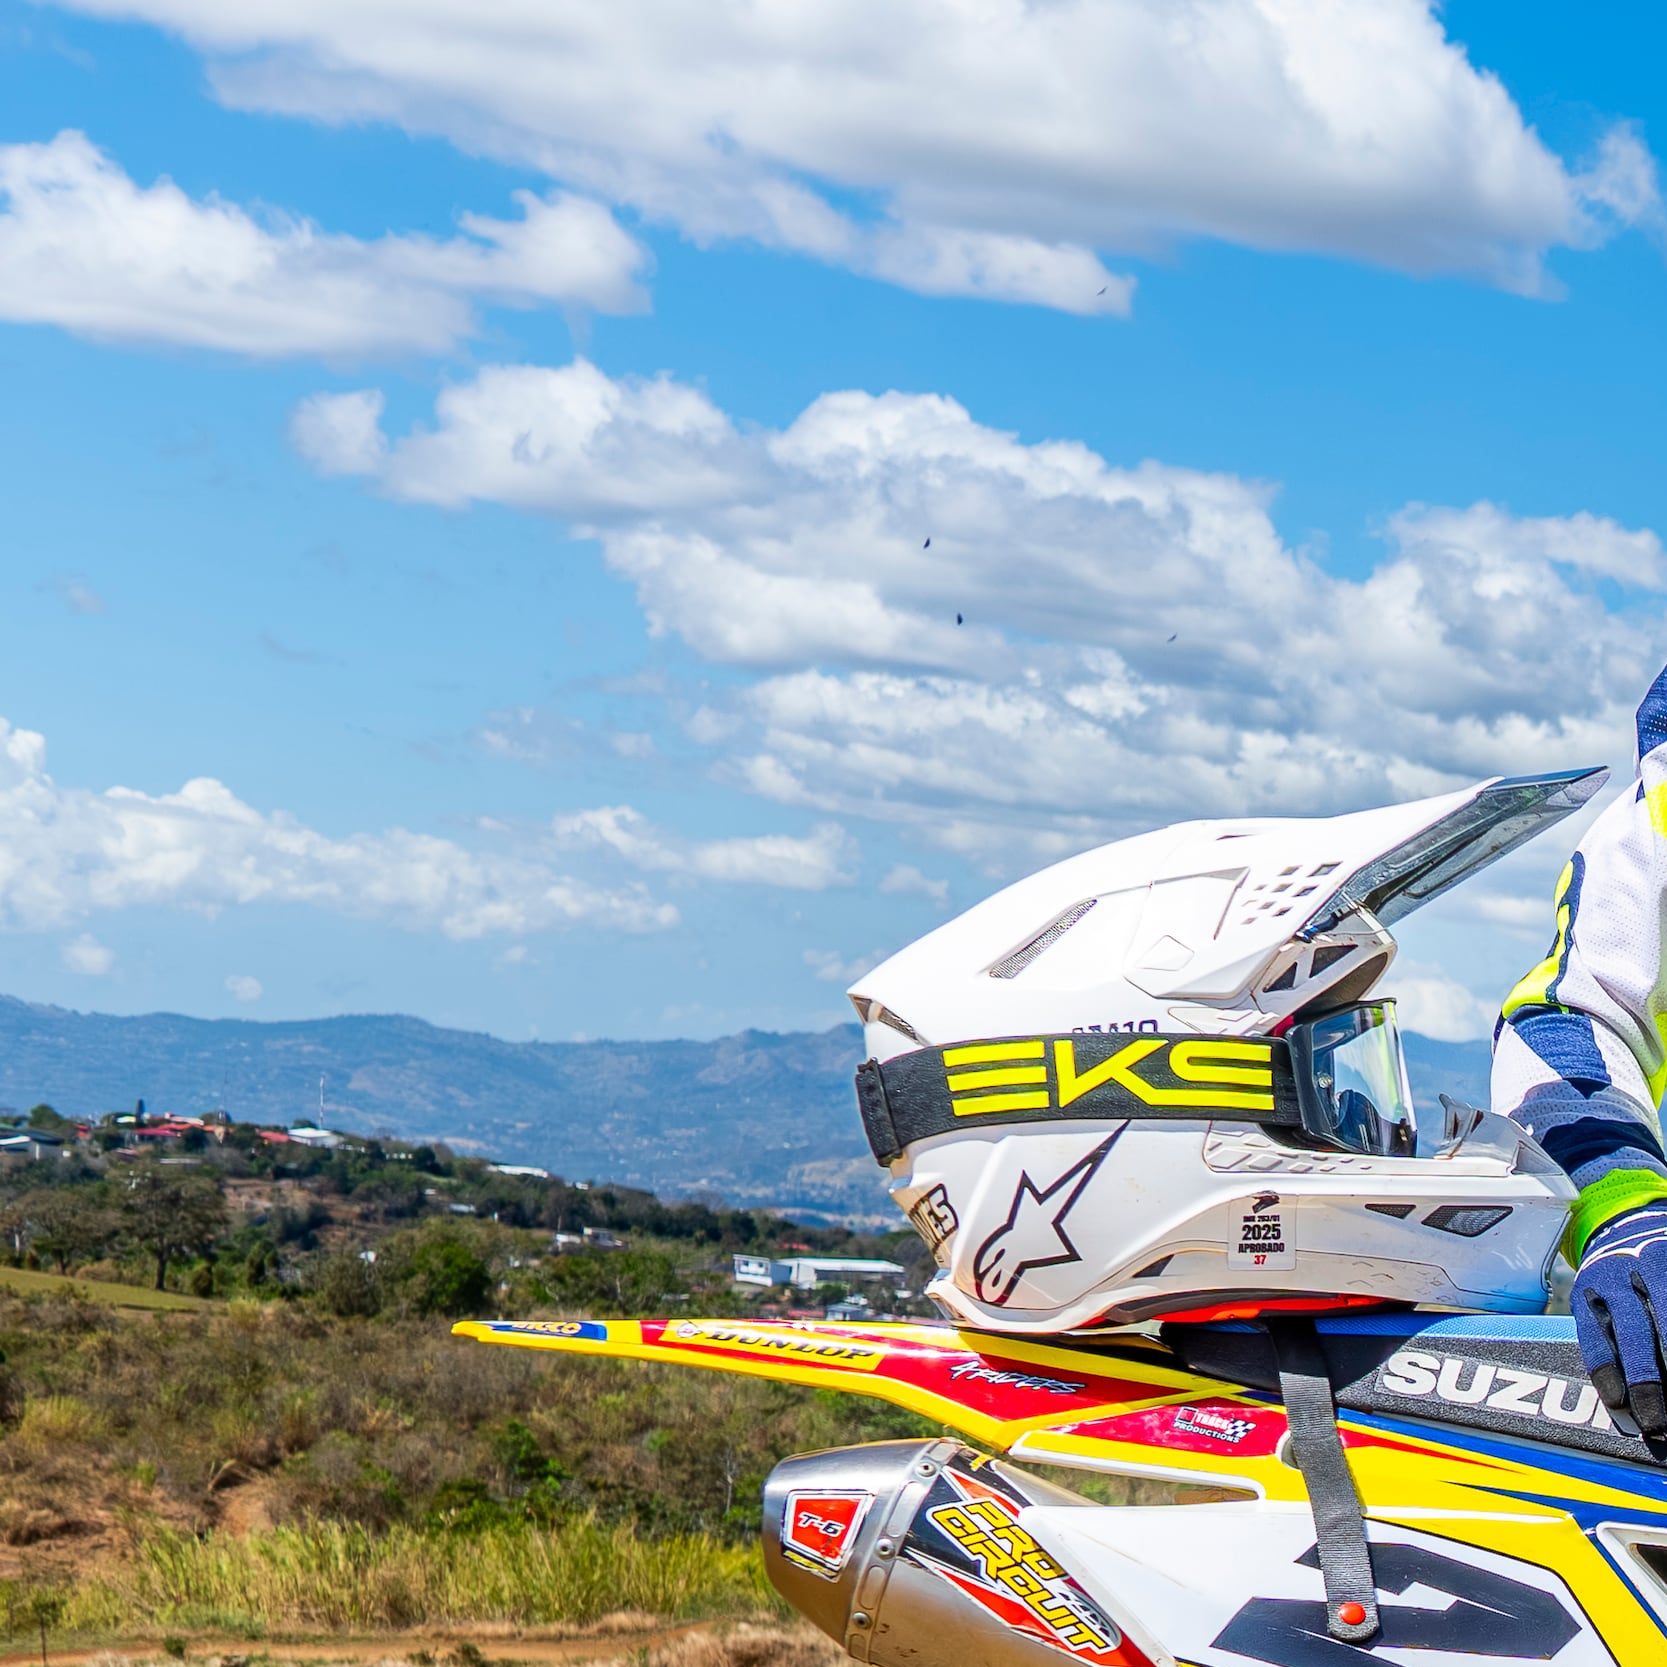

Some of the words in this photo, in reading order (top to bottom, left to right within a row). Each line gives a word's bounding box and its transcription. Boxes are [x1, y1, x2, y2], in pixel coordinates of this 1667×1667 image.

[942, 1038, 1276, 1117] EKS
[1237, 1242, 1285, 1254] APROBADO
[1241, 1223, 1282, 1241] 2025
[1253, 1254, 1267, 1265] 37
[705, 1327, 877, 1362] DUNLOP
[1382, 1352, 1614, 1431] SUZU
[1173, 1421, 1241, 1444] PRODUCTIONS
[964, 1500, 1069, 1580] PRO
[931, 1506, 1109, 1654] CIRCUIT
